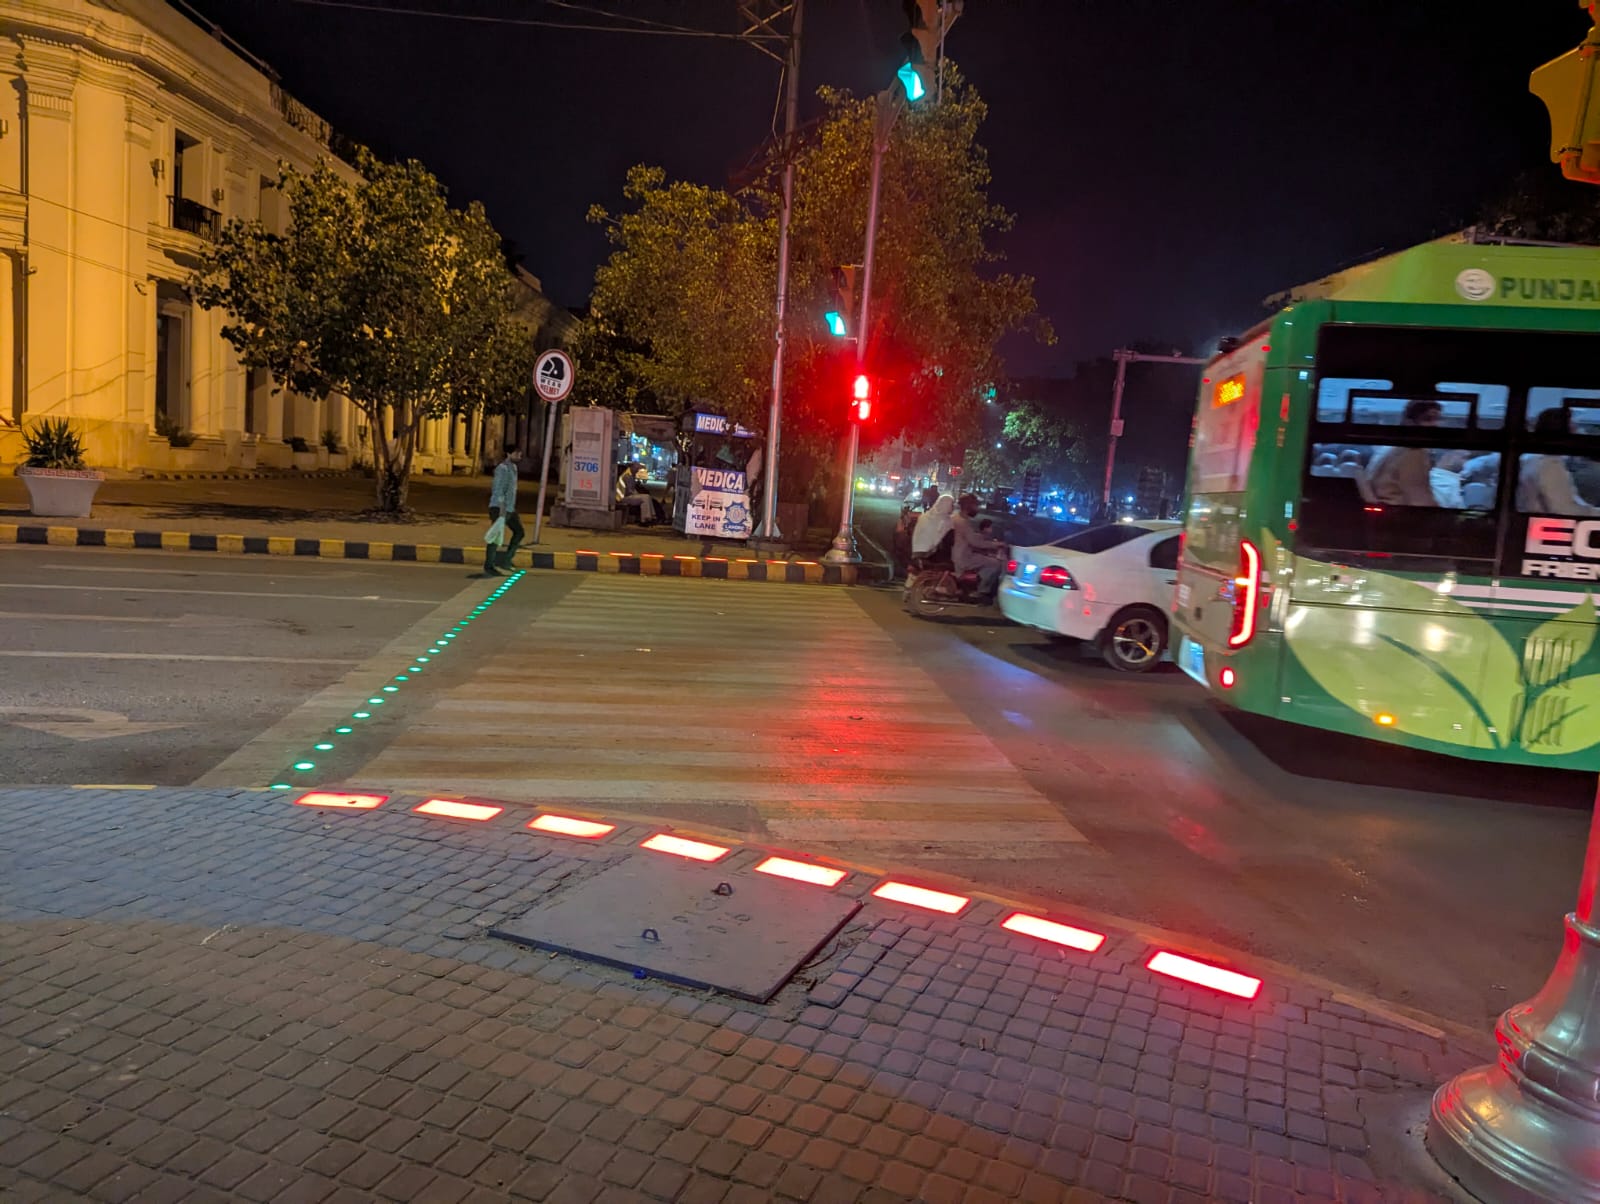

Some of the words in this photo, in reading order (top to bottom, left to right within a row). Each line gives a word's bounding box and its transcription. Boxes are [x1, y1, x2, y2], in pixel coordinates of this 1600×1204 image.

[1500, 277, 1600, 302] PUNJA
[541, 378, 561, 388] WEAR
[540, 384, 560, 395] HELMET
[574, 461, 599, 473] 3706
[694, 522, 716, 530] LANE
